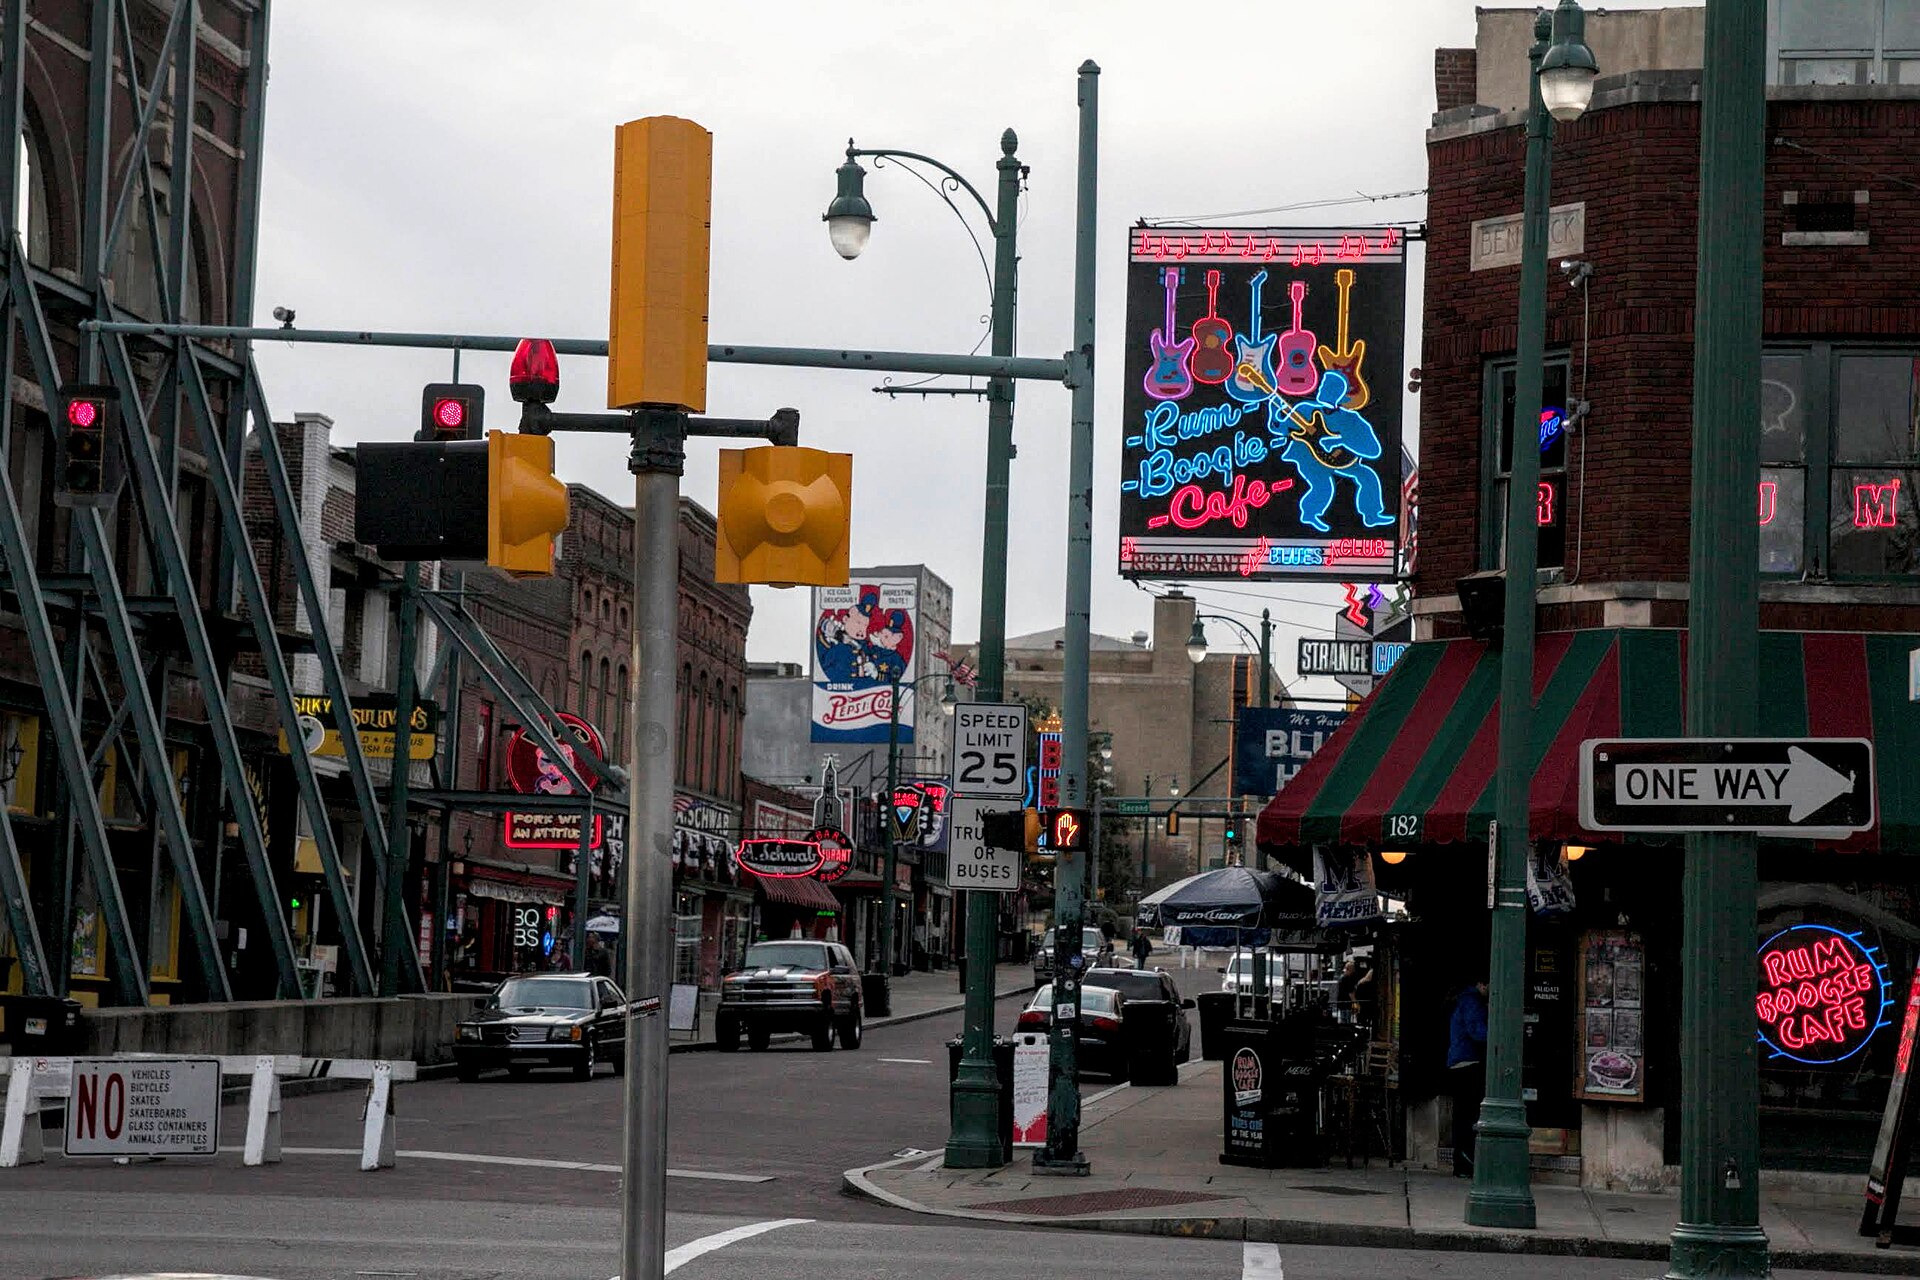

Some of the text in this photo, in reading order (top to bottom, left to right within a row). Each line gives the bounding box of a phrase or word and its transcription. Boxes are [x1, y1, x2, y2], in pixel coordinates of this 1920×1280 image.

[1144, 400, 1242, 452] Rum
[1139, 430, 1268, 498] Boogie
[1170, 474, 1271, 530] Cafe
[1338, 538, 1386, 557] CLUB
[1131, 546, 1325, 574] RESTAURANT BLUES
[1301, 641, 1370, 674] STRANGE
[826, 683, 854, 691] DRINK
[959, 714, 1021, 729] SPEED
[966, 733, 1013, 748] LIMIT
[959, 751, 1018, 785] 25
[1626, 768, 1790, 800] ONE WAY
[513, 814, 553, 824] PORK
[1389, 814, 1419, 837] 182
[512, 827, 531, 839] AN
[954, 826, 985, 840] TRU
[759, 843, 817, 863] Schwab
[974, 846, 995, 861] OR
[956, 864, 1012, 879] BUSES
[1177, 911, 1205, 920] BUD
[1207, 911, 1244, 921] LIGHT
[1763, 936, 1856, 987] RUM
[1756, 963, 1874, 1024] BOOGIE
[1778, 995, 1868, 1050] CAFE
[131, 1070, 171, 1080] VEHICLES
[130, 1083, 170, 1093] BICYCLES
[77, 1072, 125, 1140] NO
[130, 1096, 161, 1106] SKATES
[129, 1109, 187, 1118] SKATEBOARDS
[128, 1121, 208, 1132] GLASS CONTAINERS
[127, 1134, 208, 1145] ANIMALS/REPTILES
